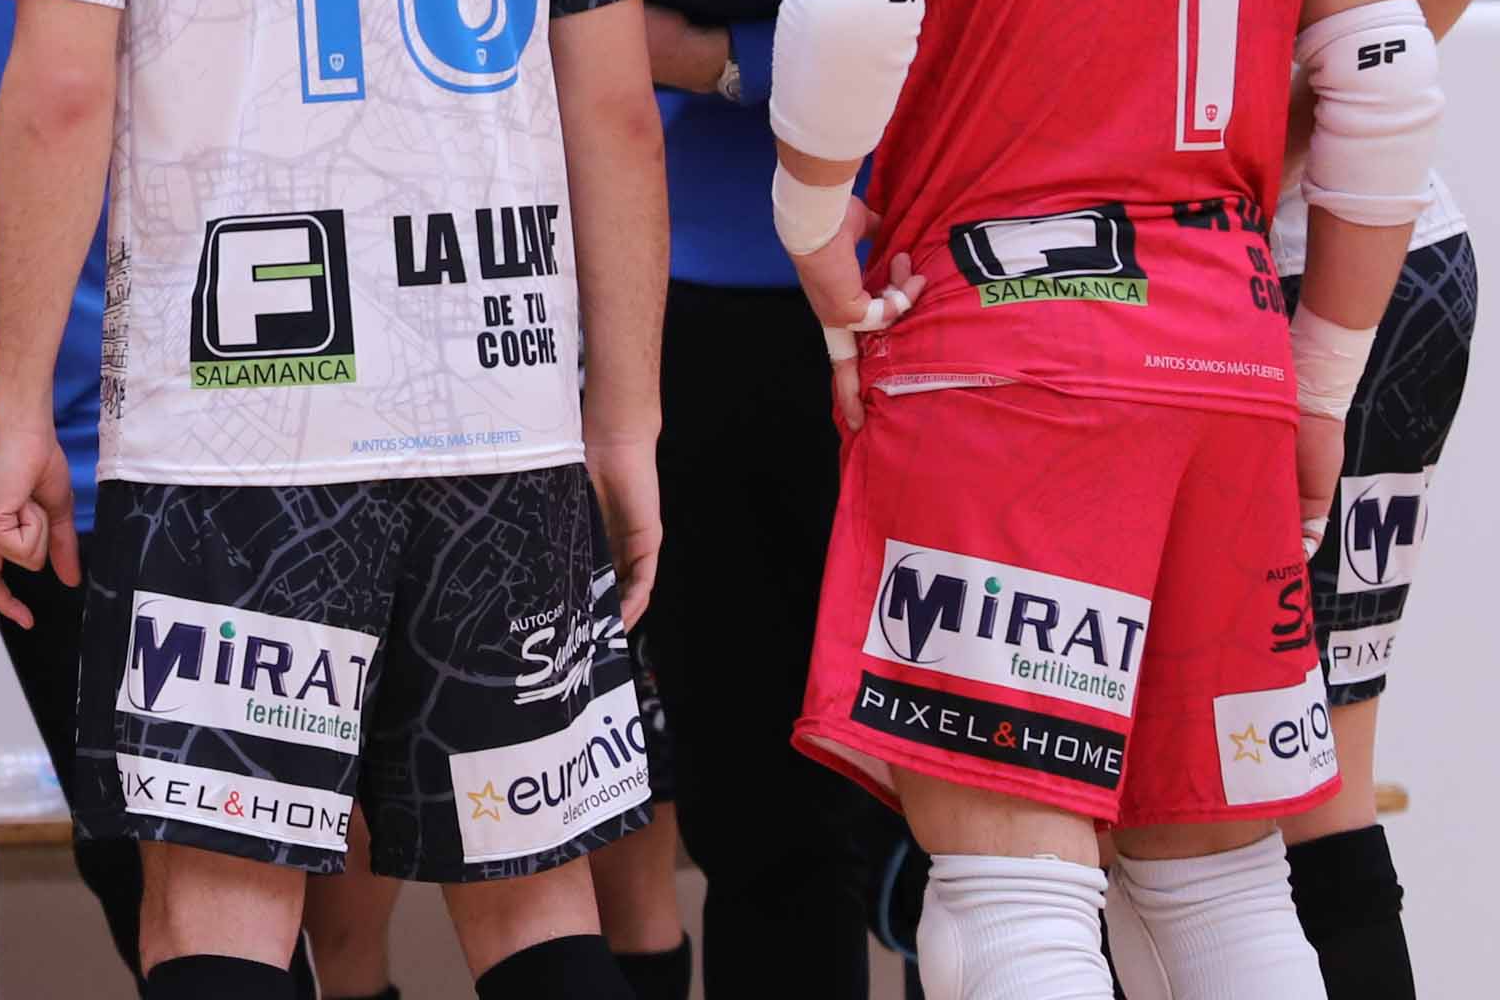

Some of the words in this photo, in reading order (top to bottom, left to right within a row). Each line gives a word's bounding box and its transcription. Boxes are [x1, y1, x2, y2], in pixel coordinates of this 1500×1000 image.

[1358, 39, 1406, 71] SP
[393, 213, 467, 287] LA
[986, 278, 1141, 304] SALAMANCA
[483, 294, 514, 327] DE
[524, 292, 547, 325] TU
[477, 328, 557, 369] COCHE
[1144, 354, 1185, 370] JUNTOS
[1186, 359, 1226, 374] SOMOS
[195, 359, 351, 387] SALAMANCA
[1010, 652, 1127, 702] fertilizantes
[245, 698, 358, 740] fertilizantes
